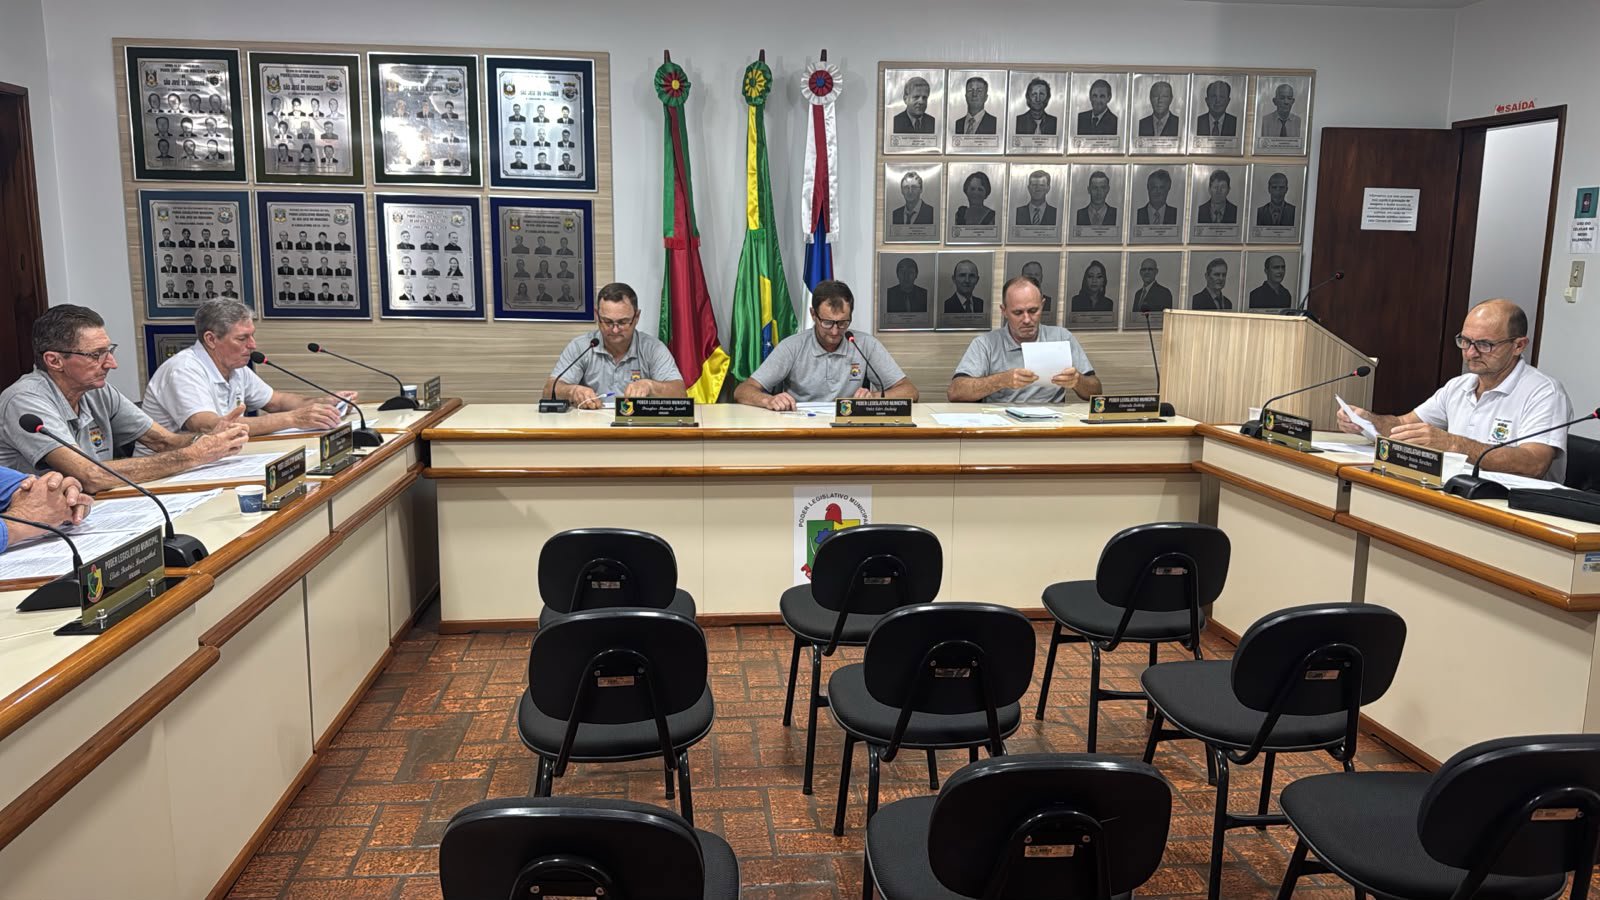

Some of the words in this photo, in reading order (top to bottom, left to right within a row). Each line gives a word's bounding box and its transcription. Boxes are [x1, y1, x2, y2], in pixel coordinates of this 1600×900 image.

[1505, 100, 1535, 112] SAÍDA
[1421, 451, 1438, 462] MUNICIPAL
[798, 505, 809, 528] PODER
[808, 492, 849, 507] LEGISLATIVO
[105, 555, 118, 571] PODER
[117, 544, 140, 564] LEGISLATIVO
[140, 535, 158, 551] MUNICIPAL
